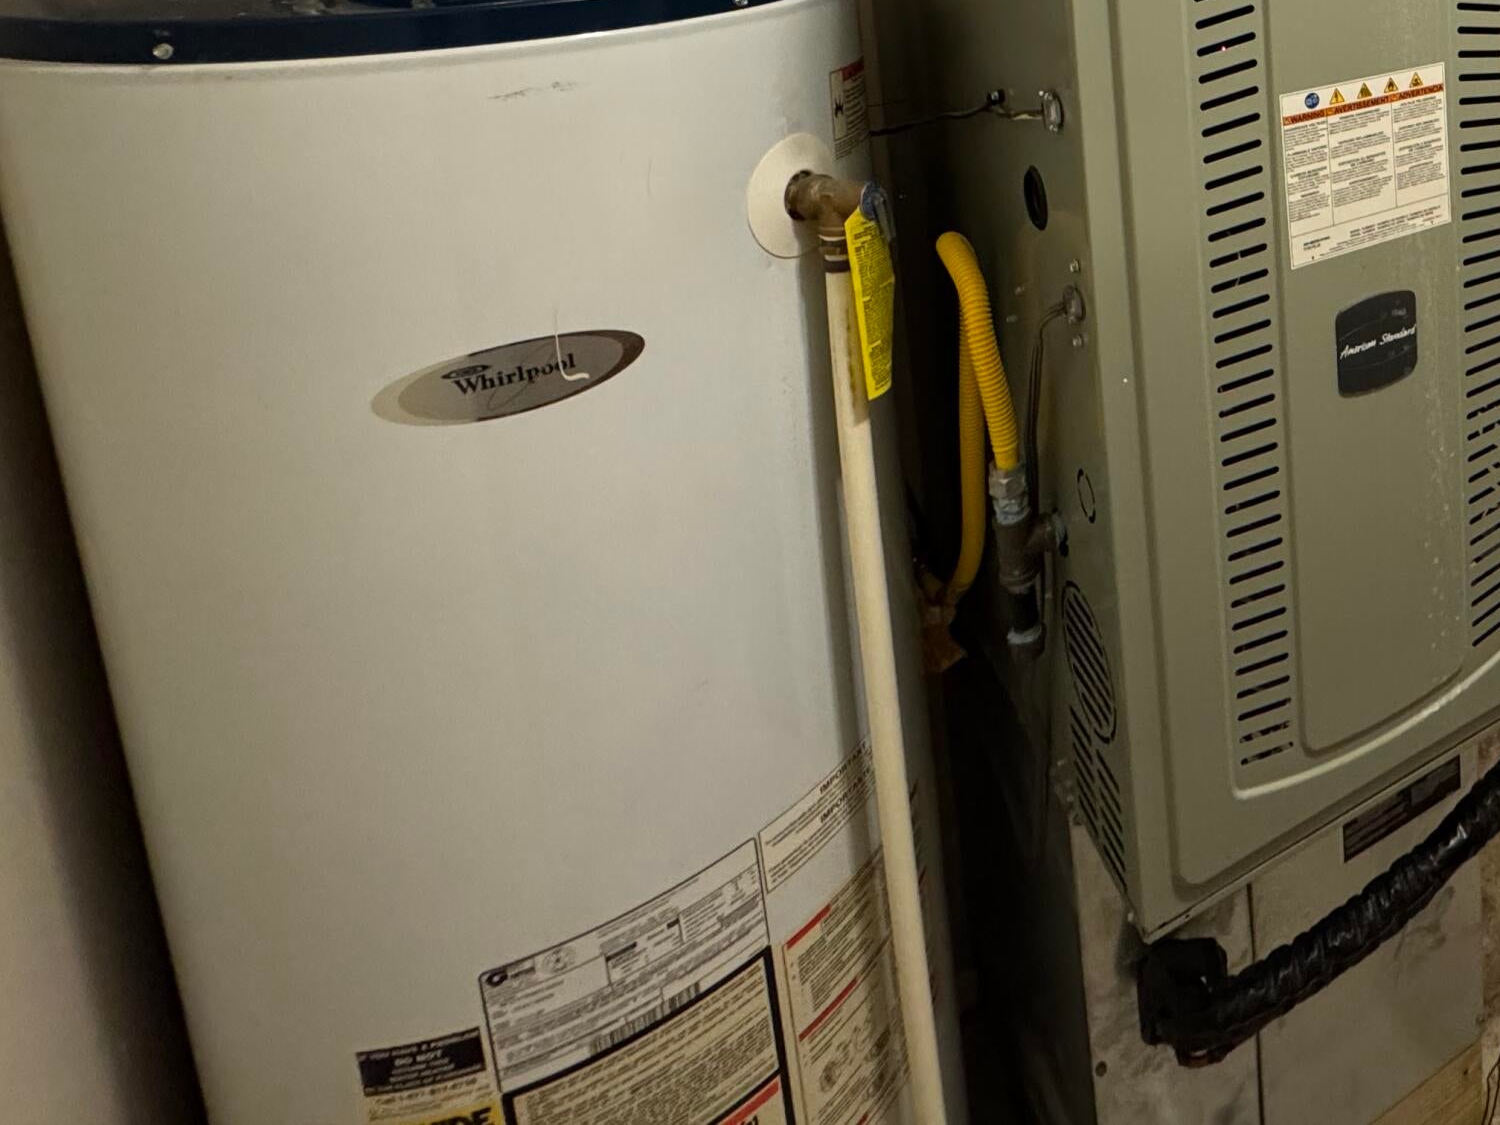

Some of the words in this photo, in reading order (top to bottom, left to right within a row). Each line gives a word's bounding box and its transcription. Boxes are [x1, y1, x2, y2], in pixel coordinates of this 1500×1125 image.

[1290, 111, 1325, 124] WARNING
[1335, 95, 1391, 115] AVERTISSEMENT
[1399, 83, 1444, 101] ADVERTENCIA
[1340, 338, 1377, 360] American
[1379, 323, 1416, 346] Standard
[453, 353, 576, 395] Whirlpool
